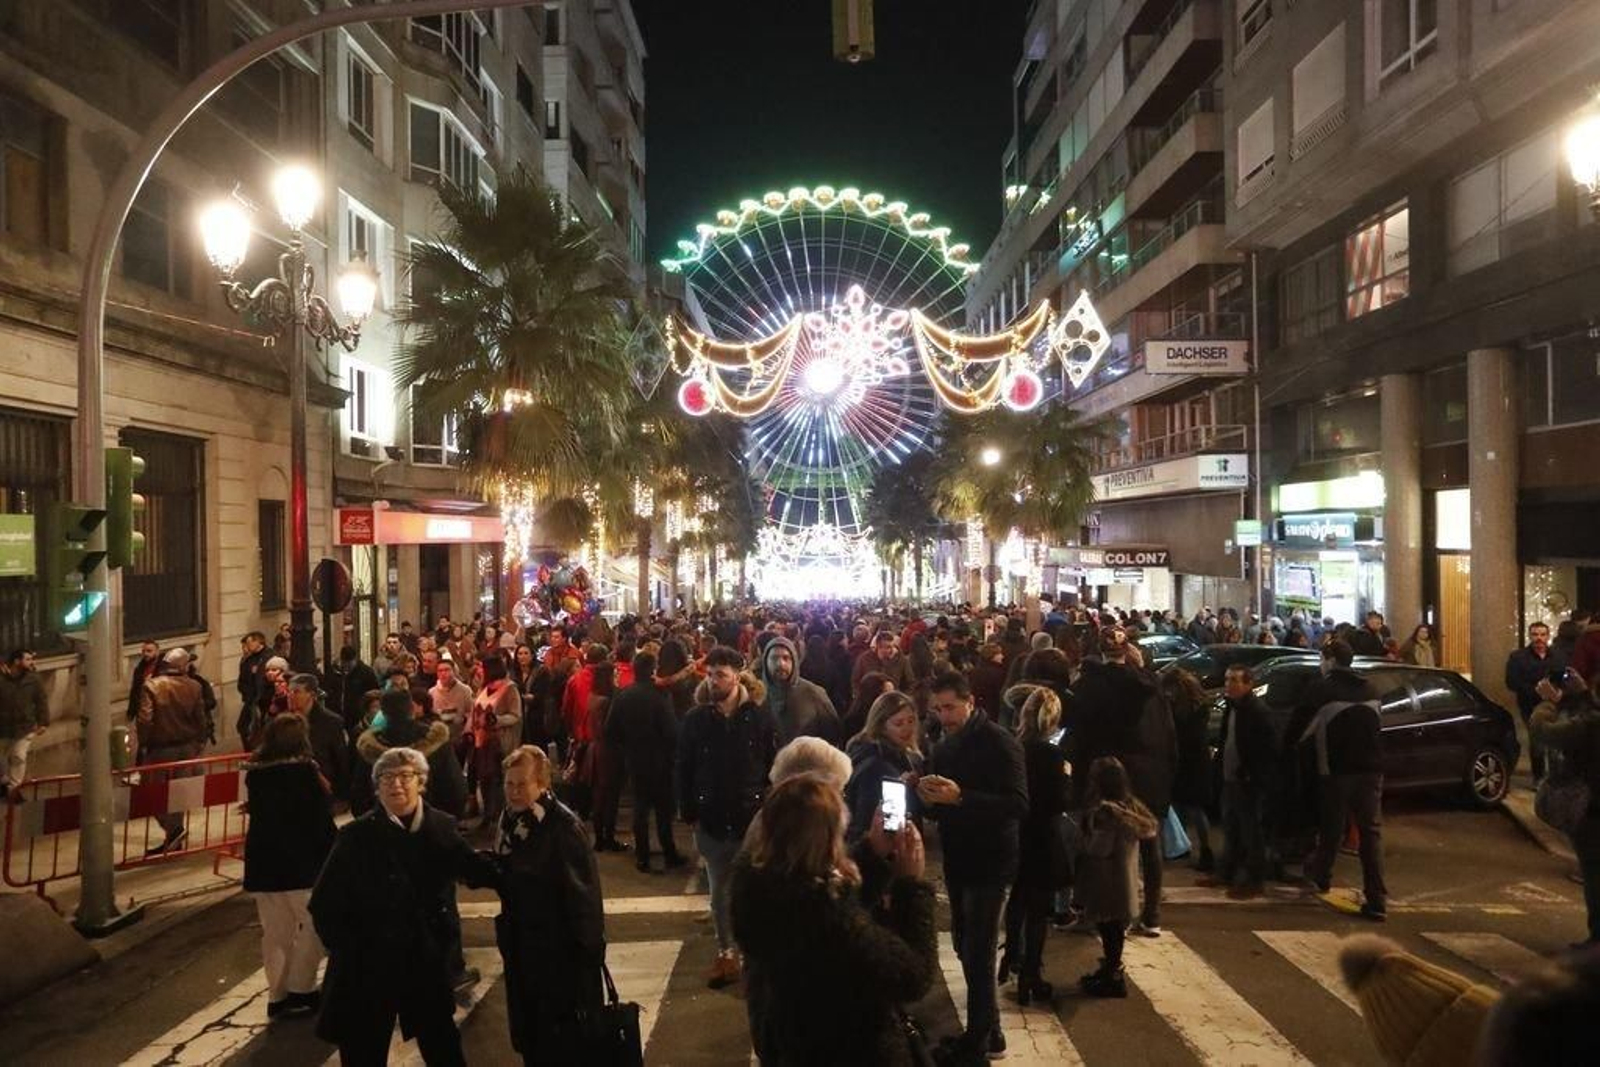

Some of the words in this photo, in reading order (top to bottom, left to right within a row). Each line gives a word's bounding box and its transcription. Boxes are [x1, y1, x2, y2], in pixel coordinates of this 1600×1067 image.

[1166, 347, 1228, 359] DACHSER
[1110, 466, 1154, 486] PREVENTIVA
[1200, 474, 1246, 482] PREVENTIVA
